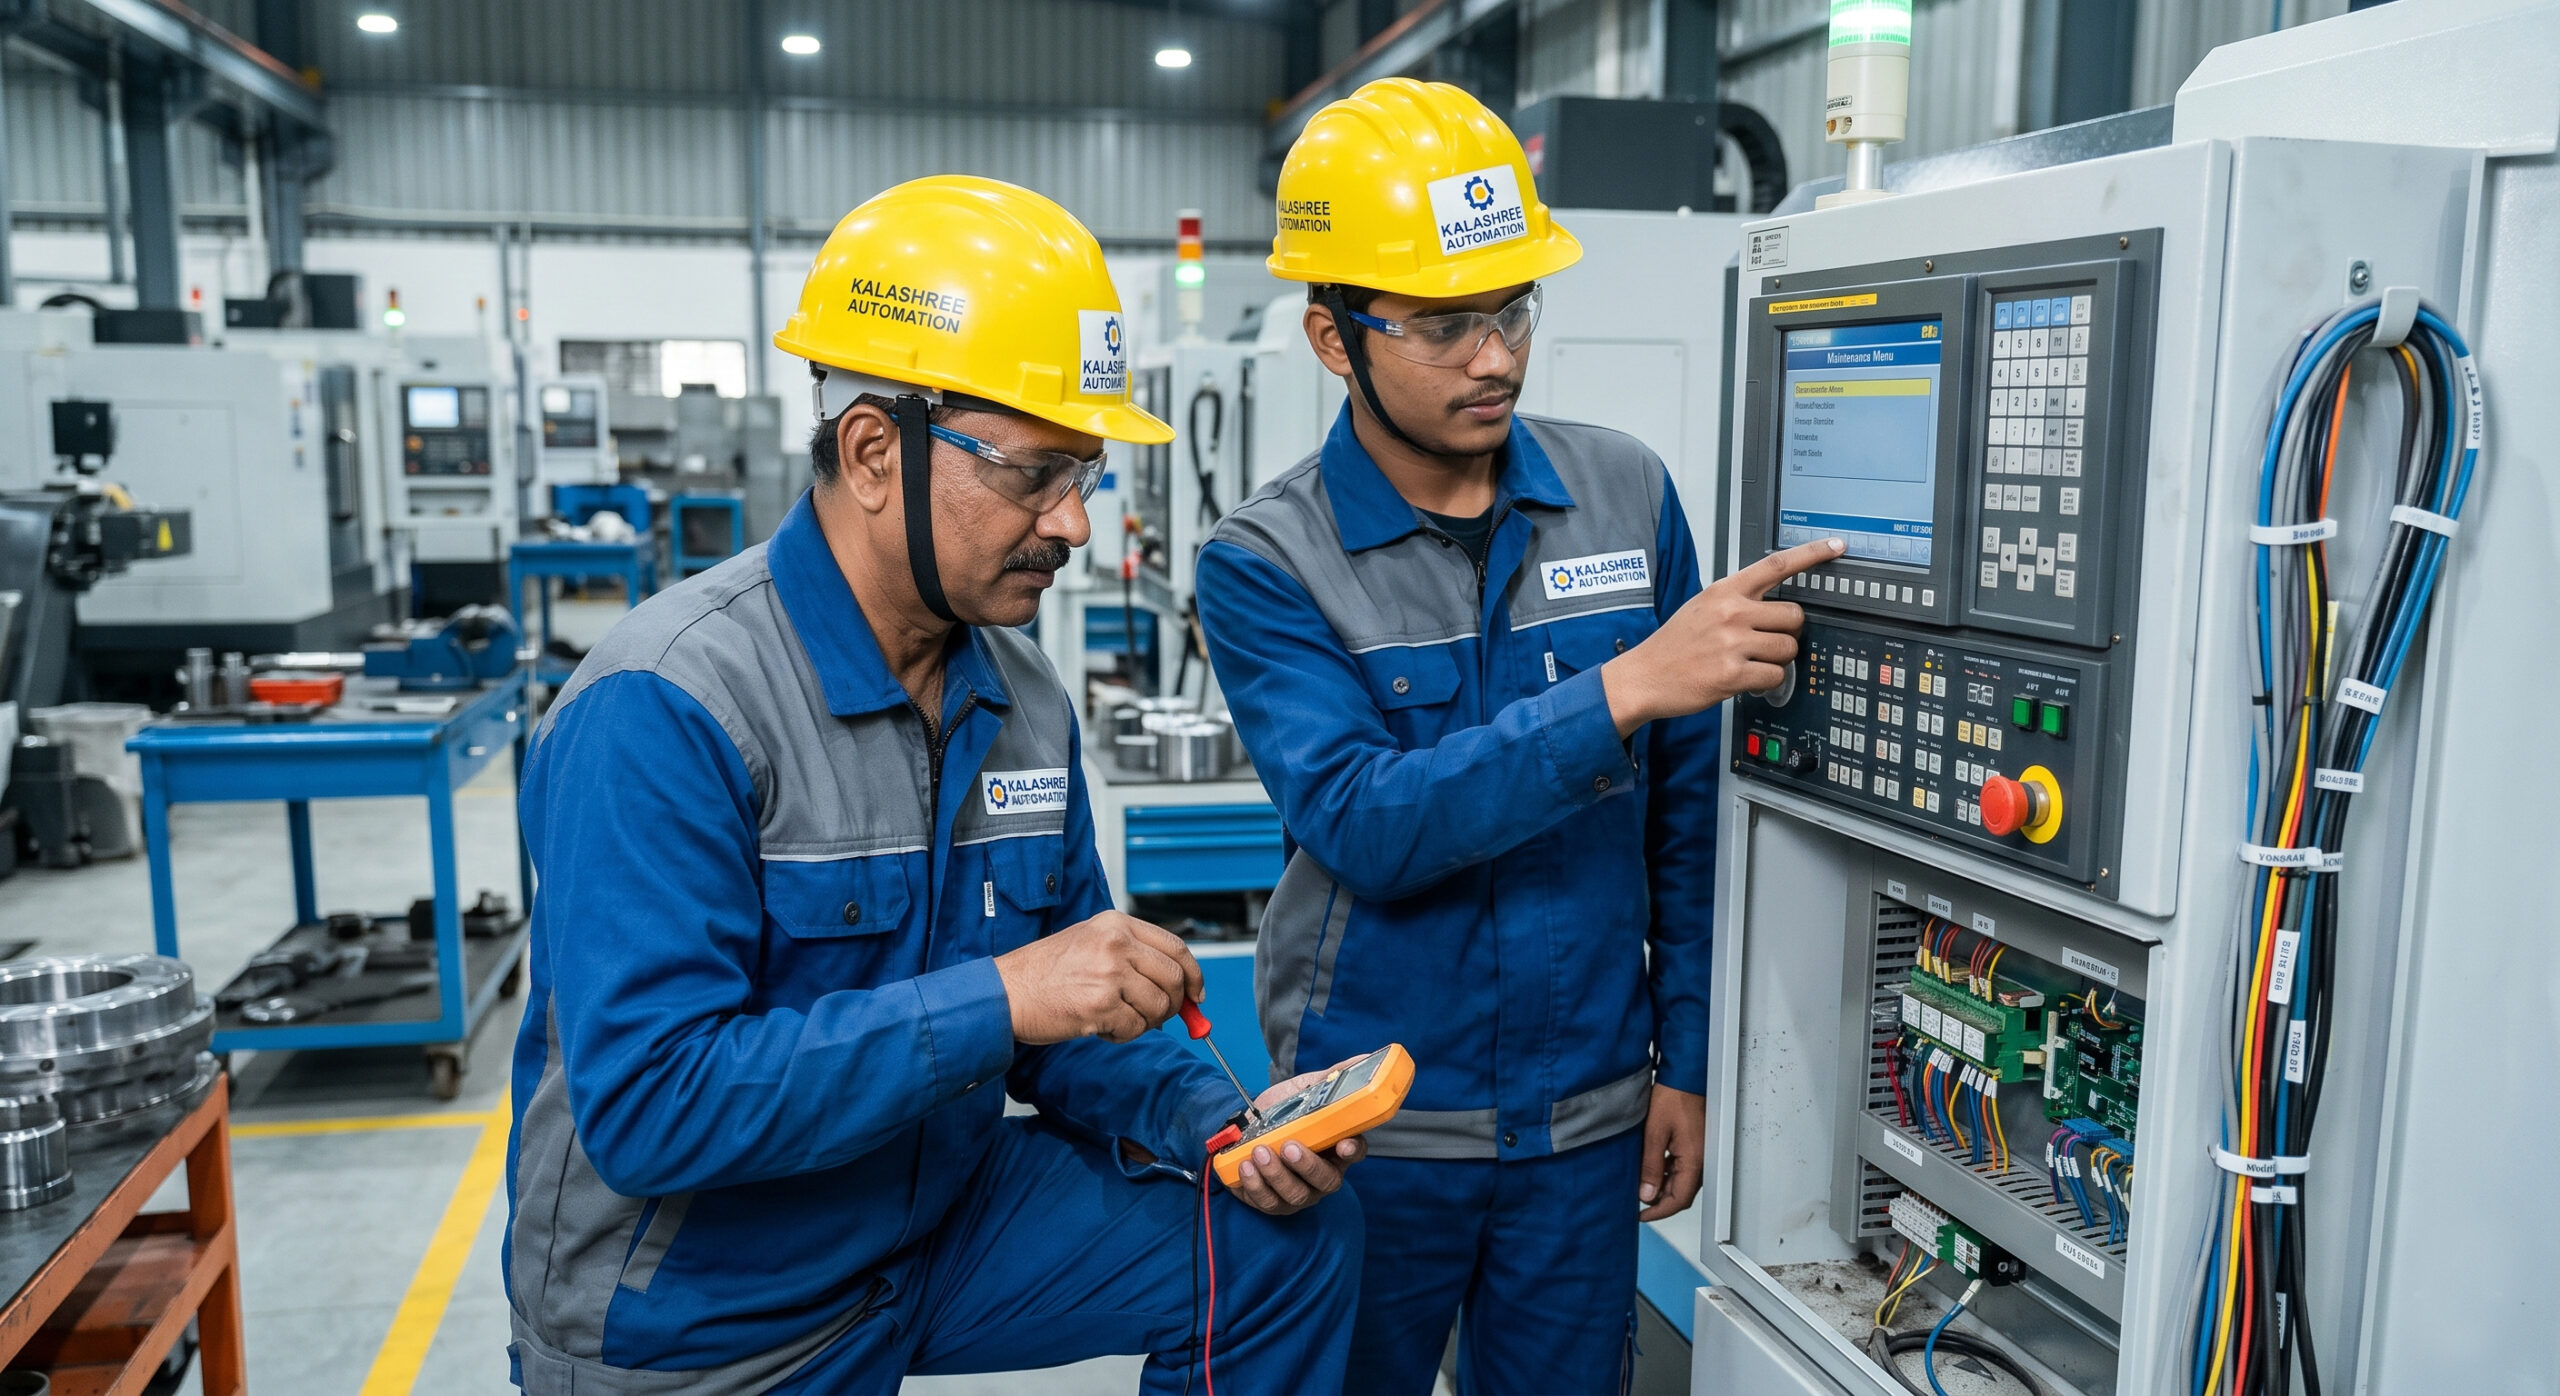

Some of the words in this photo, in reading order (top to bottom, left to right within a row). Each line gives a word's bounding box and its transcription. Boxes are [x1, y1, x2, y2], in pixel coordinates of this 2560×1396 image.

[1280, 217, 1331, 232] UTOMATION
[1441, 206, 1523, 238] KALASHREE
[1447, 222, 1525, 251] AUTOMATION
[851, 278, 966, 315] KALASHREE
[847, 298, 960, 334] AUTOMATION
[1872, 350, 1894, 361] Menu
[1997, 368, 2002, 378] 4
[2015, 368, 2021, 378] 5
[2014, 396, 2020, 406] 2
[2033, 398, 2038, 408] 3
[1575, 556, 1645, 577] KALASHREE
